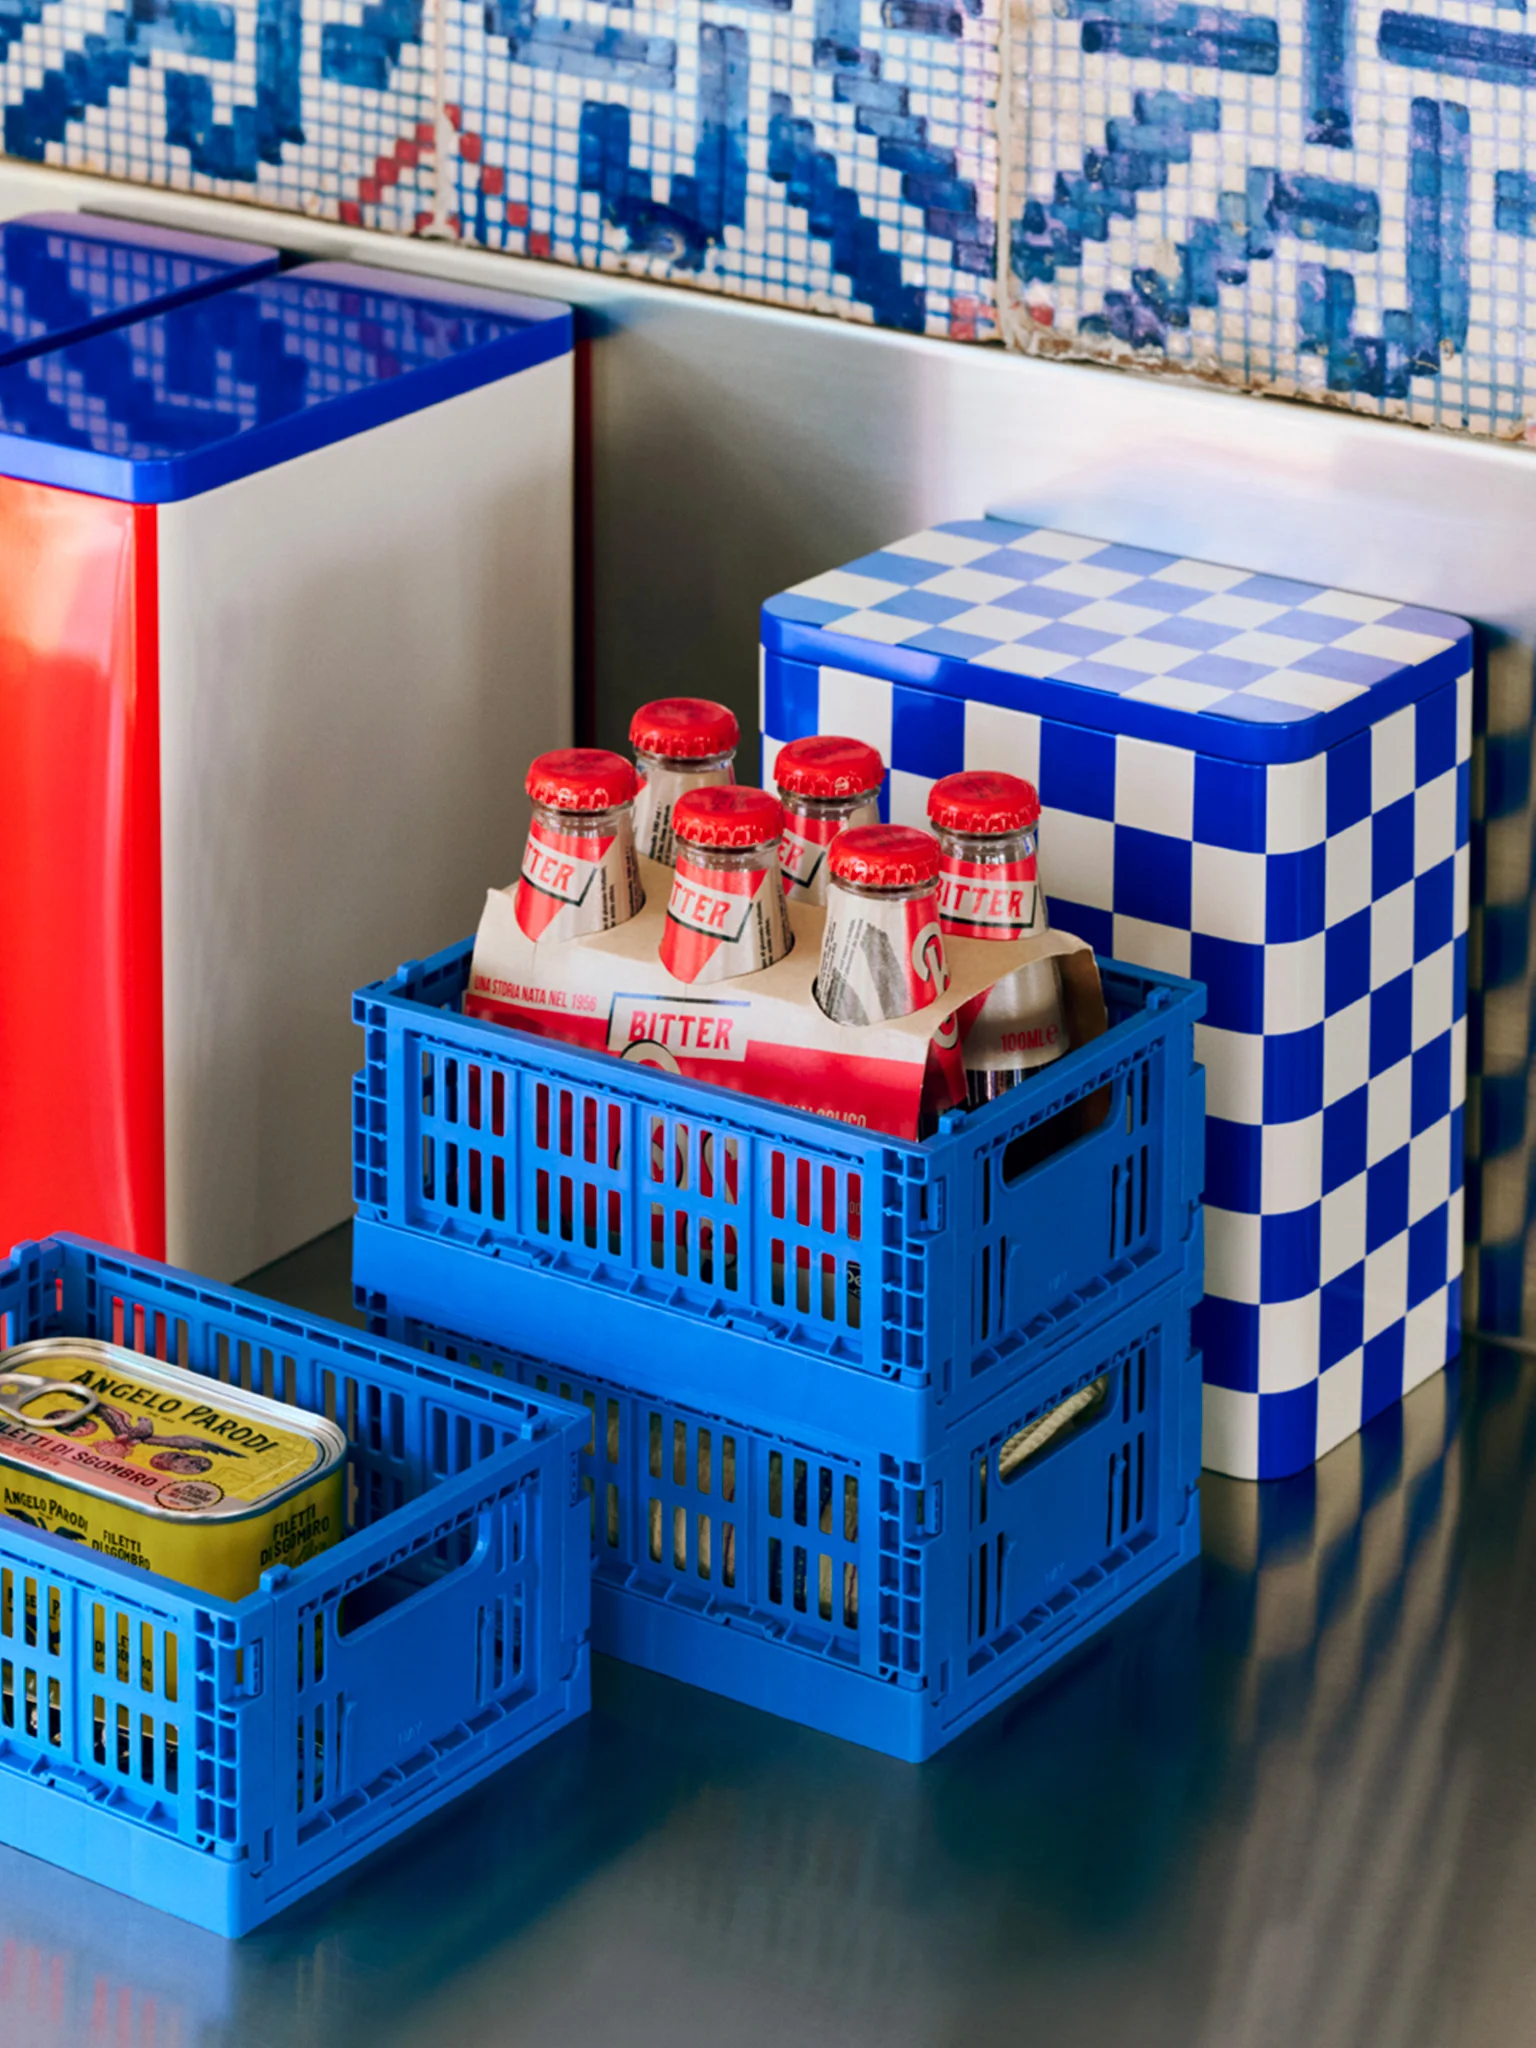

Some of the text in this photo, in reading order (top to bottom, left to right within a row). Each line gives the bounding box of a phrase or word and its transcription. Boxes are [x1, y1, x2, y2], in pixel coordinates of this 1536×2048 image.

[474, 975, 491, 992] UNA
[491, 979, 521, 999] STORIA
[521, 986, 547, 1005] NATA
[547, 990, 568, 1009] NEL
[627, 1010, 735, 1051] BITTER
[1002, 1027, 1045, 1054] 100ML
[69, 1369, 280, 1455] ANGELO PARODI
[50, 1443, 75, 1456] DI
[71, 1450, 159, 1488] SGOMBRO
[3, 1487, 89, 1533] ANGELO PARODI
[272, 1503, 316, 1541] FILETTI
[103, 1529, 141, 1553] FILETTI
[274, 1515, 331, 1558] SGOMBRO
